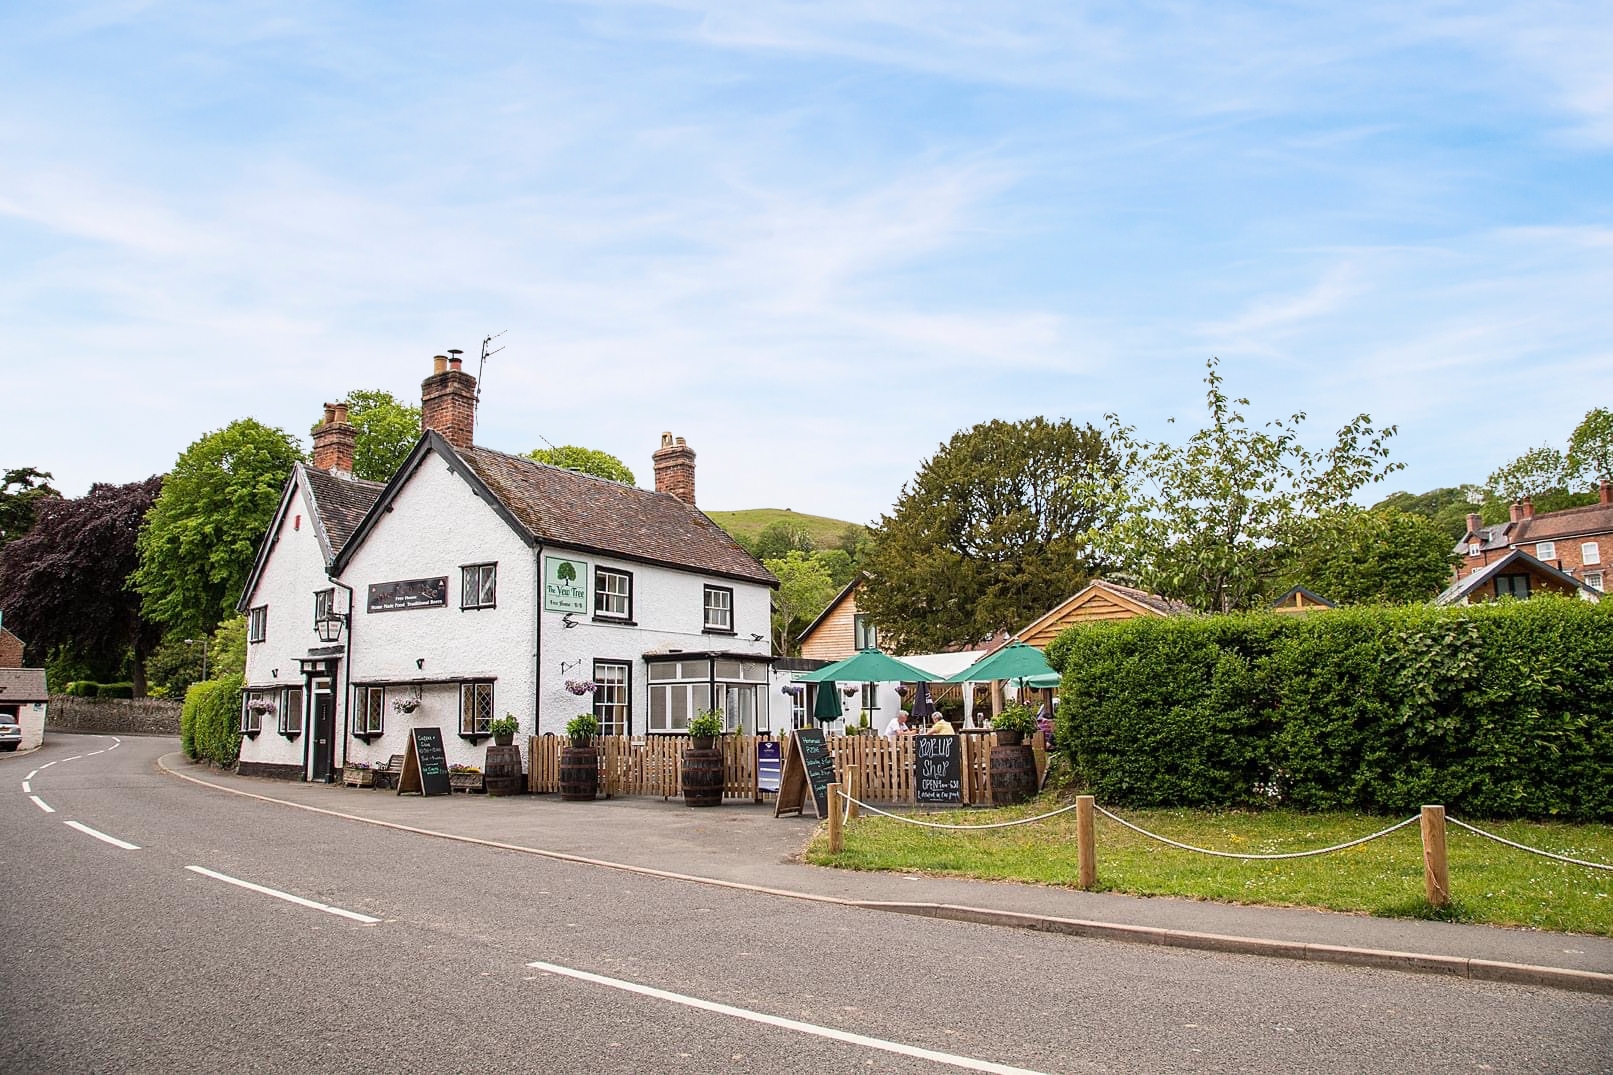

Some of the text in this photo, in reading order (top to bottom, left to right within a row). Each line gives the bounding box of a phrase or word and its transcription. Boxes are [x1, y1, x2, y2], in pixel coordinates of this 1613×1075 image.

[548, 585, 585, 598] The Yew Tree
[922, 779, 938, 790] OPEN
